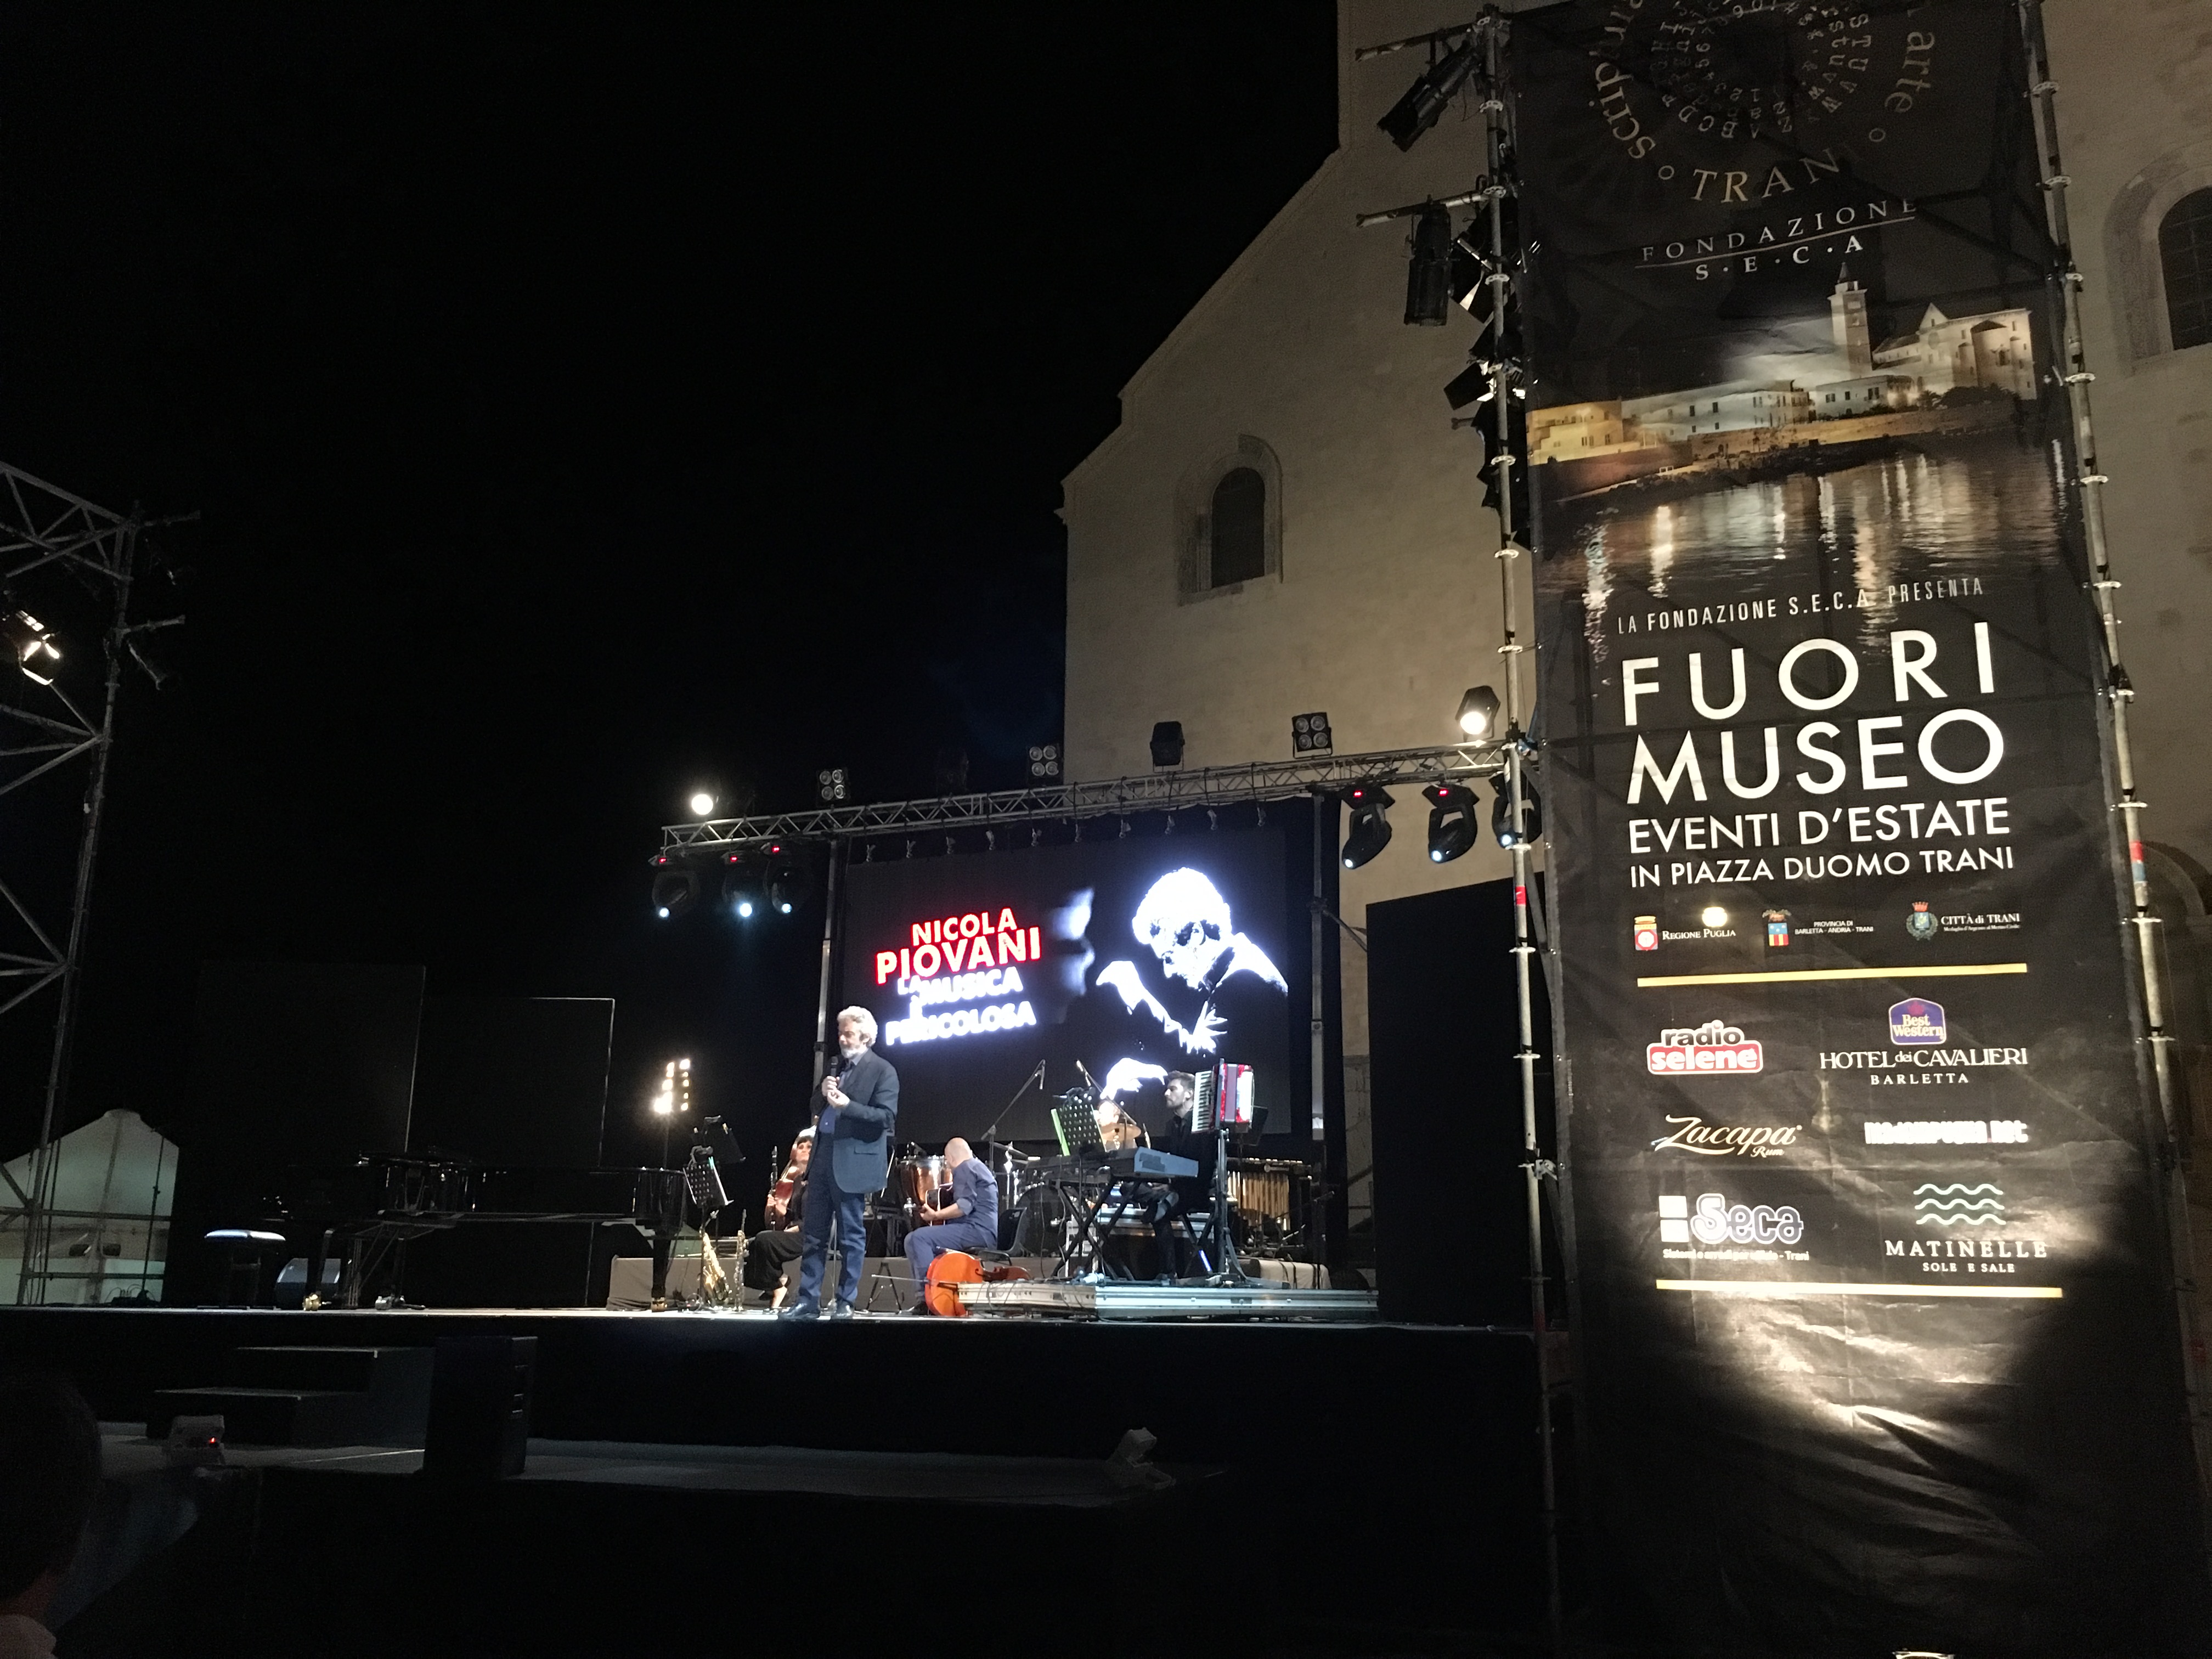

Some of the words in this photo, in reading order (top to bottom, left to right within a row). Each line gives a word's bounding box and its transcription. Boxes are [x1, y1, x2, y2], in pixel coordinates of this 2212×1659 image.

[1690, 145, 1859, 204] TRAN
[1642, 200, 1917, 261] FONDAZIONE
[1618, 615, 1637, 634] LA
[1647, 599, 1778, 631] FONDAZIONE
[1888, 578, 1983, 604] PRESENTA
[1622, 622, 1995, 726] FUORI
[1627, 708, 2004, 805] MUSEO
[1629, 812, 1780, 853] EVENTI
[1798, 797, 2010, 845] D'ESTATE
[1630, 865, 1660, 888] IN
[1671, 858, 1775, 885] PIAZZA
[1784, 851, 1910, 881] DUOMO
[1920, 845, 2014, 873] TRANI
[911, 907, 1017, 947] NICOLA
[1941, 913, 1973, 925] CITTÀ
[1975, 915, 1984, 924] di
[1987, 913, 2021, 923] TRANI
[876, 926, 1041, 985] PIOVANI
[1664, 1021, 1741, 1046] radio
[1892, 1024, 1943, 1037] Western
[1902, 1014, 1931, 1027] Best
[1820, 1051, 1896, 1069] HOTEL
[1895, 1050, 1912, 1063] dei
[1914, 1048, 2029, 1067] CAVALIERI
[1870, 1073, 1969, 1086] BARLETTA
[1655, 1114, 1796, 1155] Zacapa
[1750, 1146, 1784, 1158] Rum
[1690, 1193, 1804, 1244] Seca
[1784, 1250, 1810, 1261] Trani
[1885, 1240, 2047, 1258] MATINELLE
[1923, 1262, 1957, 1272] SOLE
[1968, 1263, 1975, 1272] E
[1981, 1263, 2015, 1273] SALE
